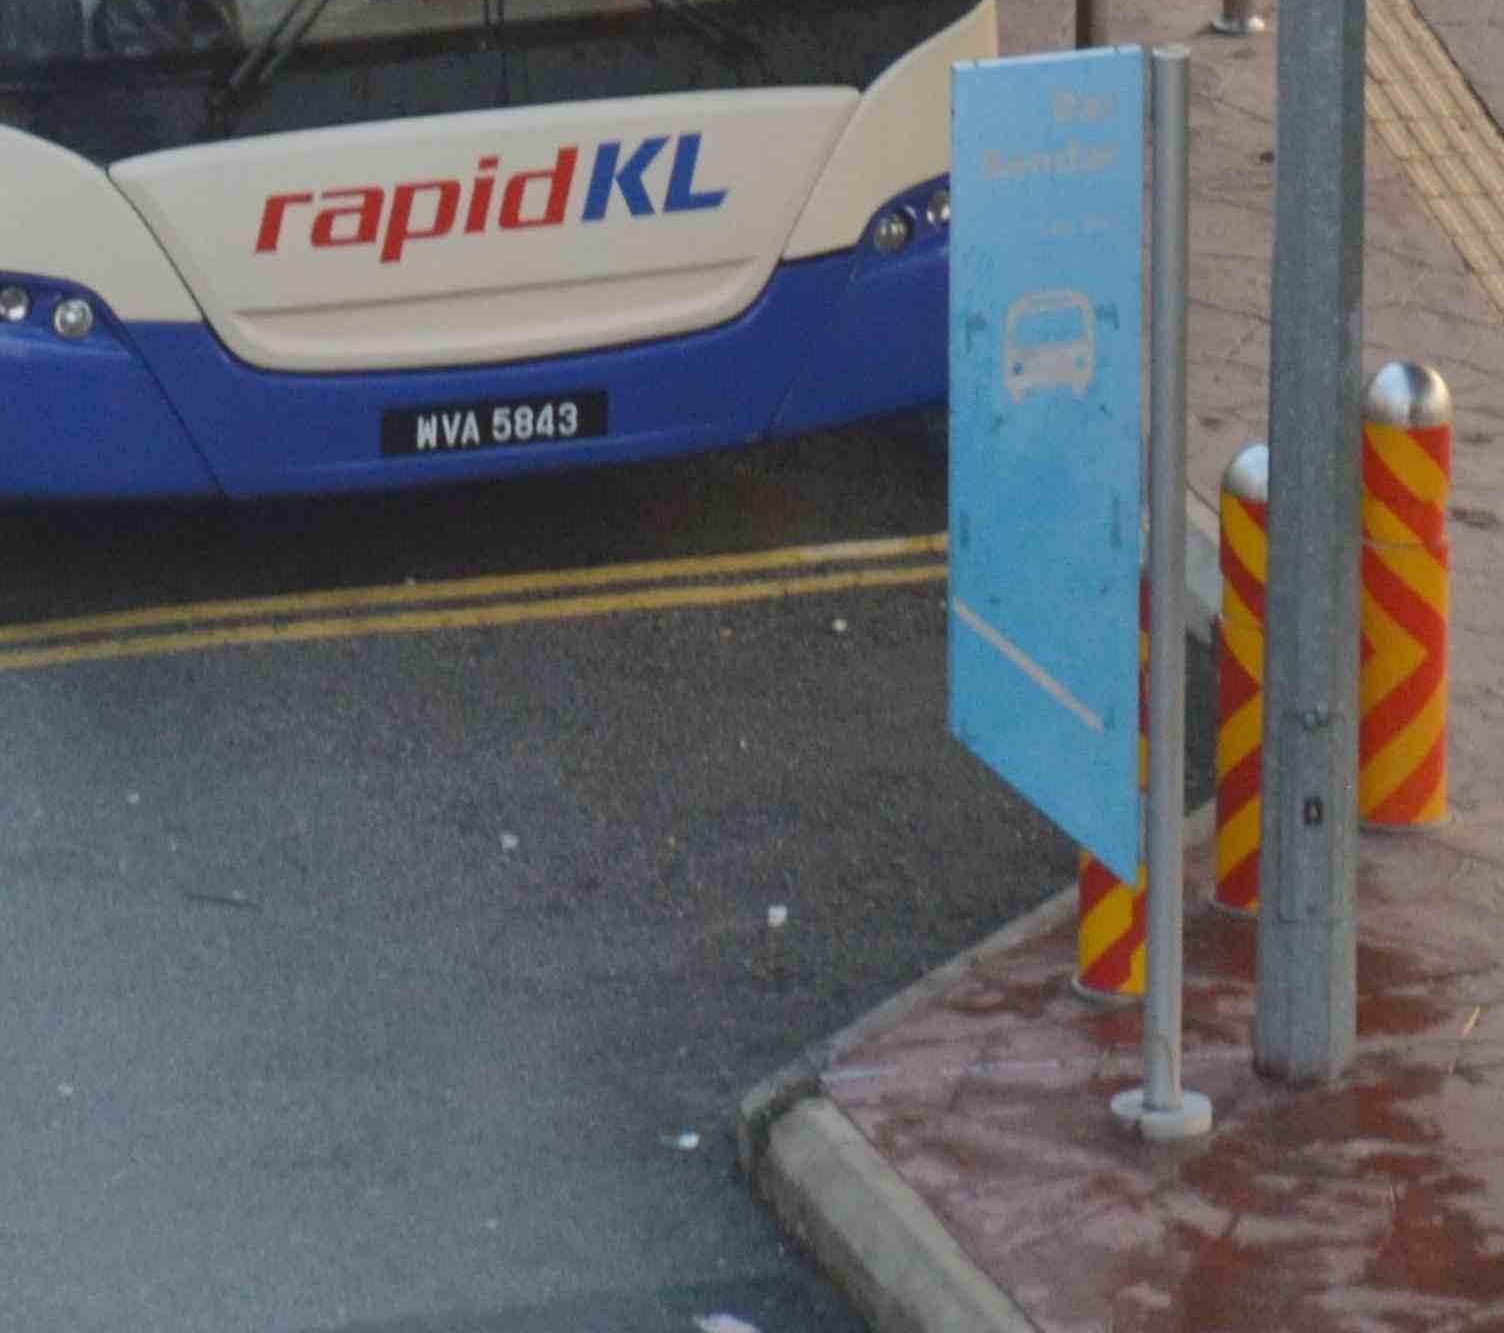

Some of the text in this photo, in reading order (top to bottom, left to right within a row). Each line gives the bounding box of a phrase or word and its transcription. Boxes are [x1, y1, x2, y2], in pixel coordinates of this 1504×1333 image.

[253, 131, 730, 265] rapidKL
[416, 402, 579, 450] WVA 5843
